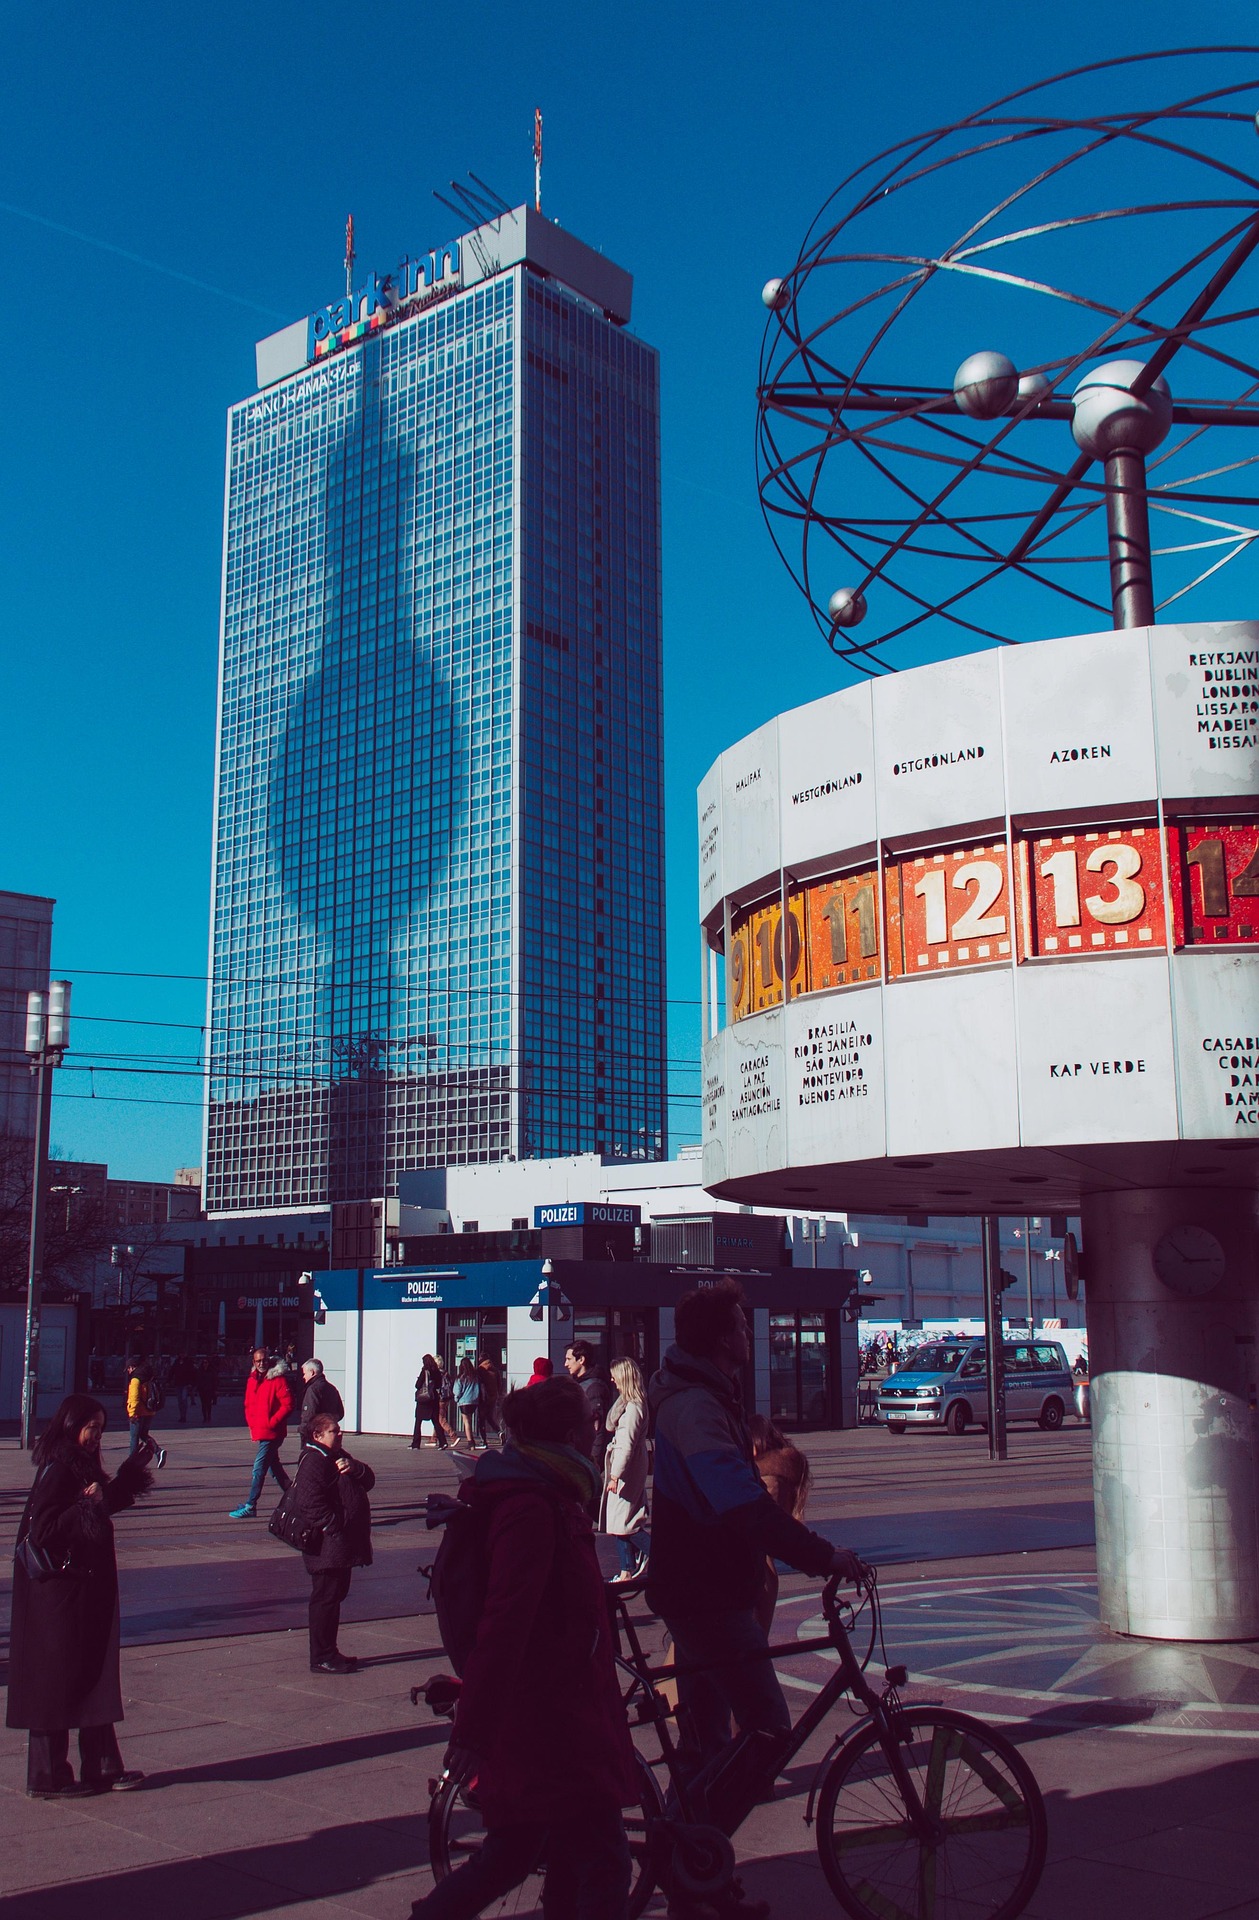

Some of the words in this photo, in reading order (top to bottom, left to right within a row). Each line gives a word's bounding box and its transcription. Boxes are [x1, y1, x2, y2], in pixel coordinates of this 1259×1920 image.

[307, 271, 391, 360] park
[398, 241, 461, 300] inn
[1204, 668, 1258, 682] DUBLIN
[1202, 684, 1259, 699] LONDON
[893, 746, 985, 776] OSTGRÖNLAND
[1049, 745, 1111, 764] AZOREN
[735, 768, 762, 793] HALIFAX
[792, 772, 863, 805] WESTGRÖNLAND
[1040, 843, 1147, 928] 13
[1187, 839, 1259, 917] 14
[914, 860, 1007, 945] 12
[821, 884, 878, 966] 11
[756, 911, 802, 989] 10
[731, 939, 745, 1007] 9
[808, 1020, 857, 1040] BRASILIA
[794, 1045, 809, 1059] RIO
[812, 1042, 823, 1055] DE
[827, 1033, 873, 1053] JANEIRO
[740, 1055, 769, 1074] CARACAS
[806, 1056, 824, 1073] SÃO
[828, 1052, 860, 1068] PAULO
[1050, 1063, 1082, 1077] KAP
[1090, 1059, 1146, 1075] VERDE
[743, 1075, 752, 1088] LA
[753, 1071, 765, 1085] PAZ
[802, 1068, 864, 1089] MONTEVIDEO
[739, 1083, 771, 1105] ASUNCIÓN
[799, 1089, 835, 1106] BUENOS
[838, 1084, 868, 1100] AIRES
[731, 1103, 760, 1122] SANTIAGO
[762, 1098, 781, 1114] CHILE
[1235, 1110, 1259, 1124] AC
[540, 1207, 577, 1223] POLIZEI
[592, 1207, 633, 1222] POLIZEI
[716, 1236, 753, 1248] PRIMARK
[407, 1281, 437, 1294] POLIZEI
[247, 1297, 278, 1307] BURGER
[1008, 1381, 1032, 1389] POLIZEI
